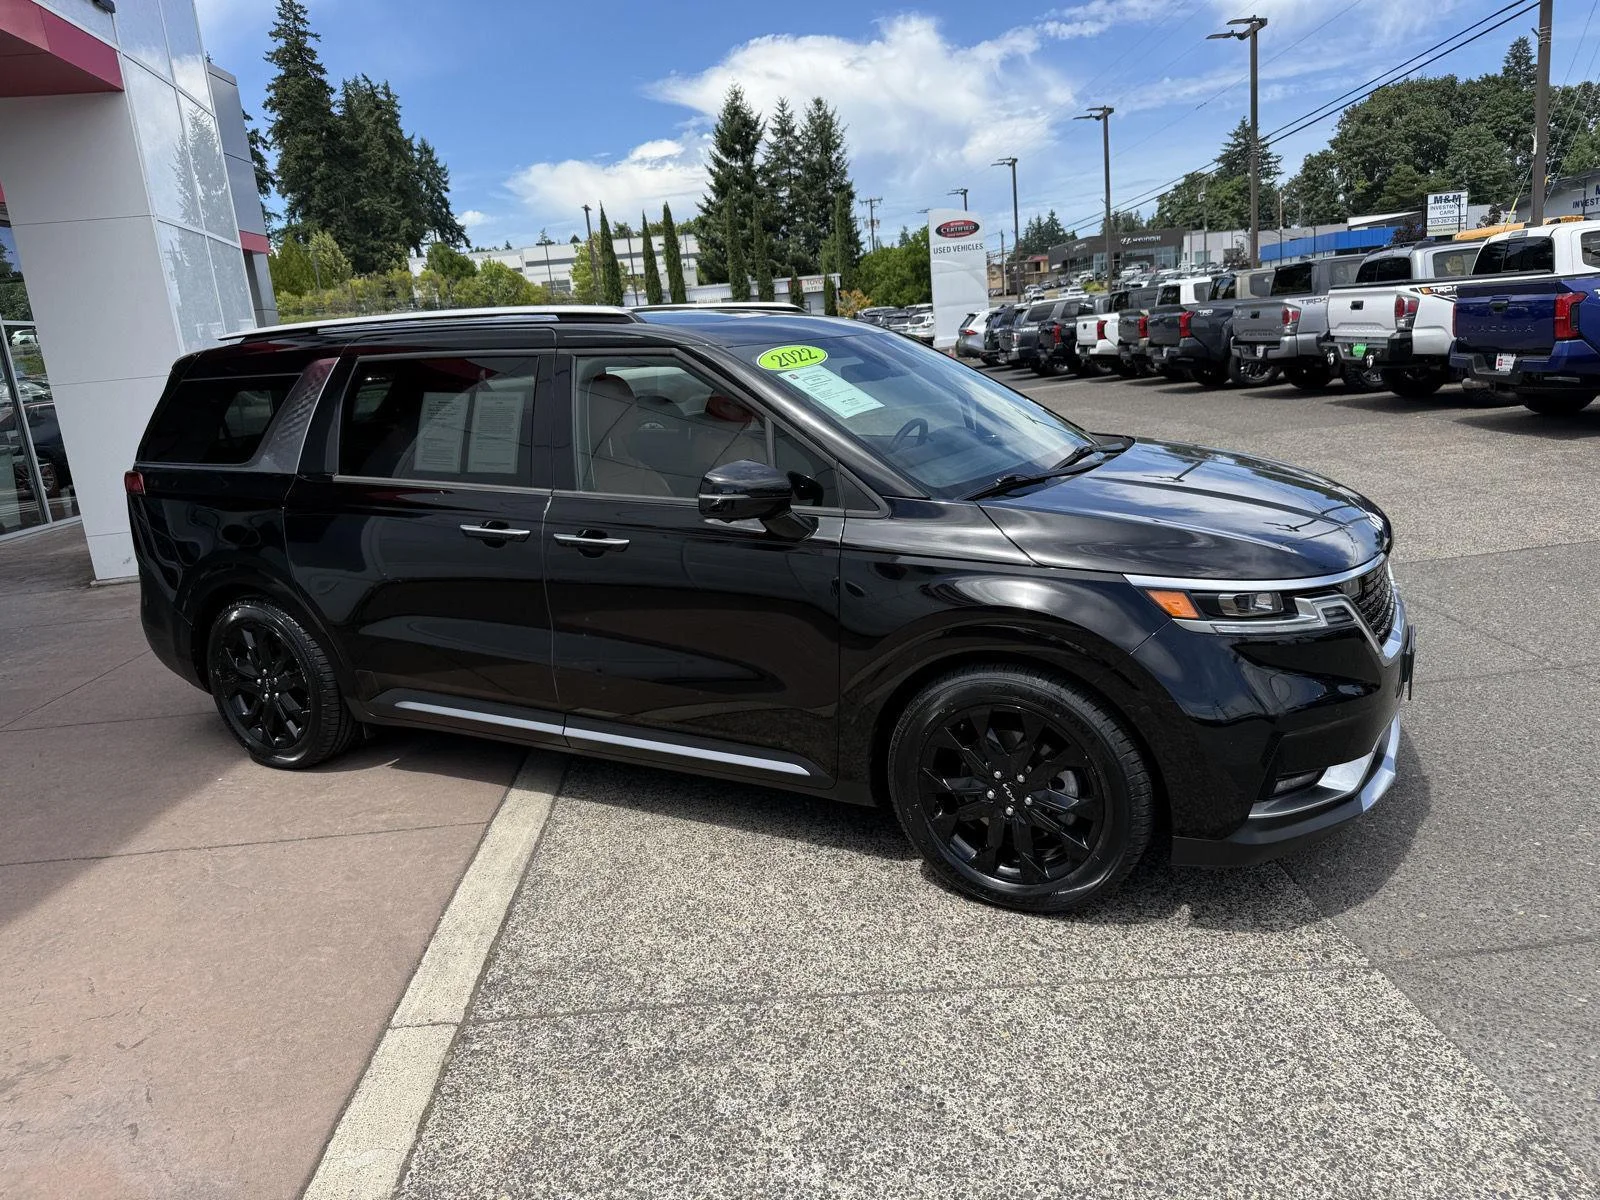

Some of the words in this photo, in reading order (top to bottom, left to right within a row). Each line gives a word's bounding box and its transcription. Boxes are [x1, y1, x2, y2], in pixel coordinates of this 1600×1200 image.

[1433, 194, 1461, 204] M&M
[940, 225, 975, 234] CERTIFIED
[933, 246, 952, 255] USED
[952, 243, 984, 253] VEHICLES
[770, 347, 819, 368] 2022
